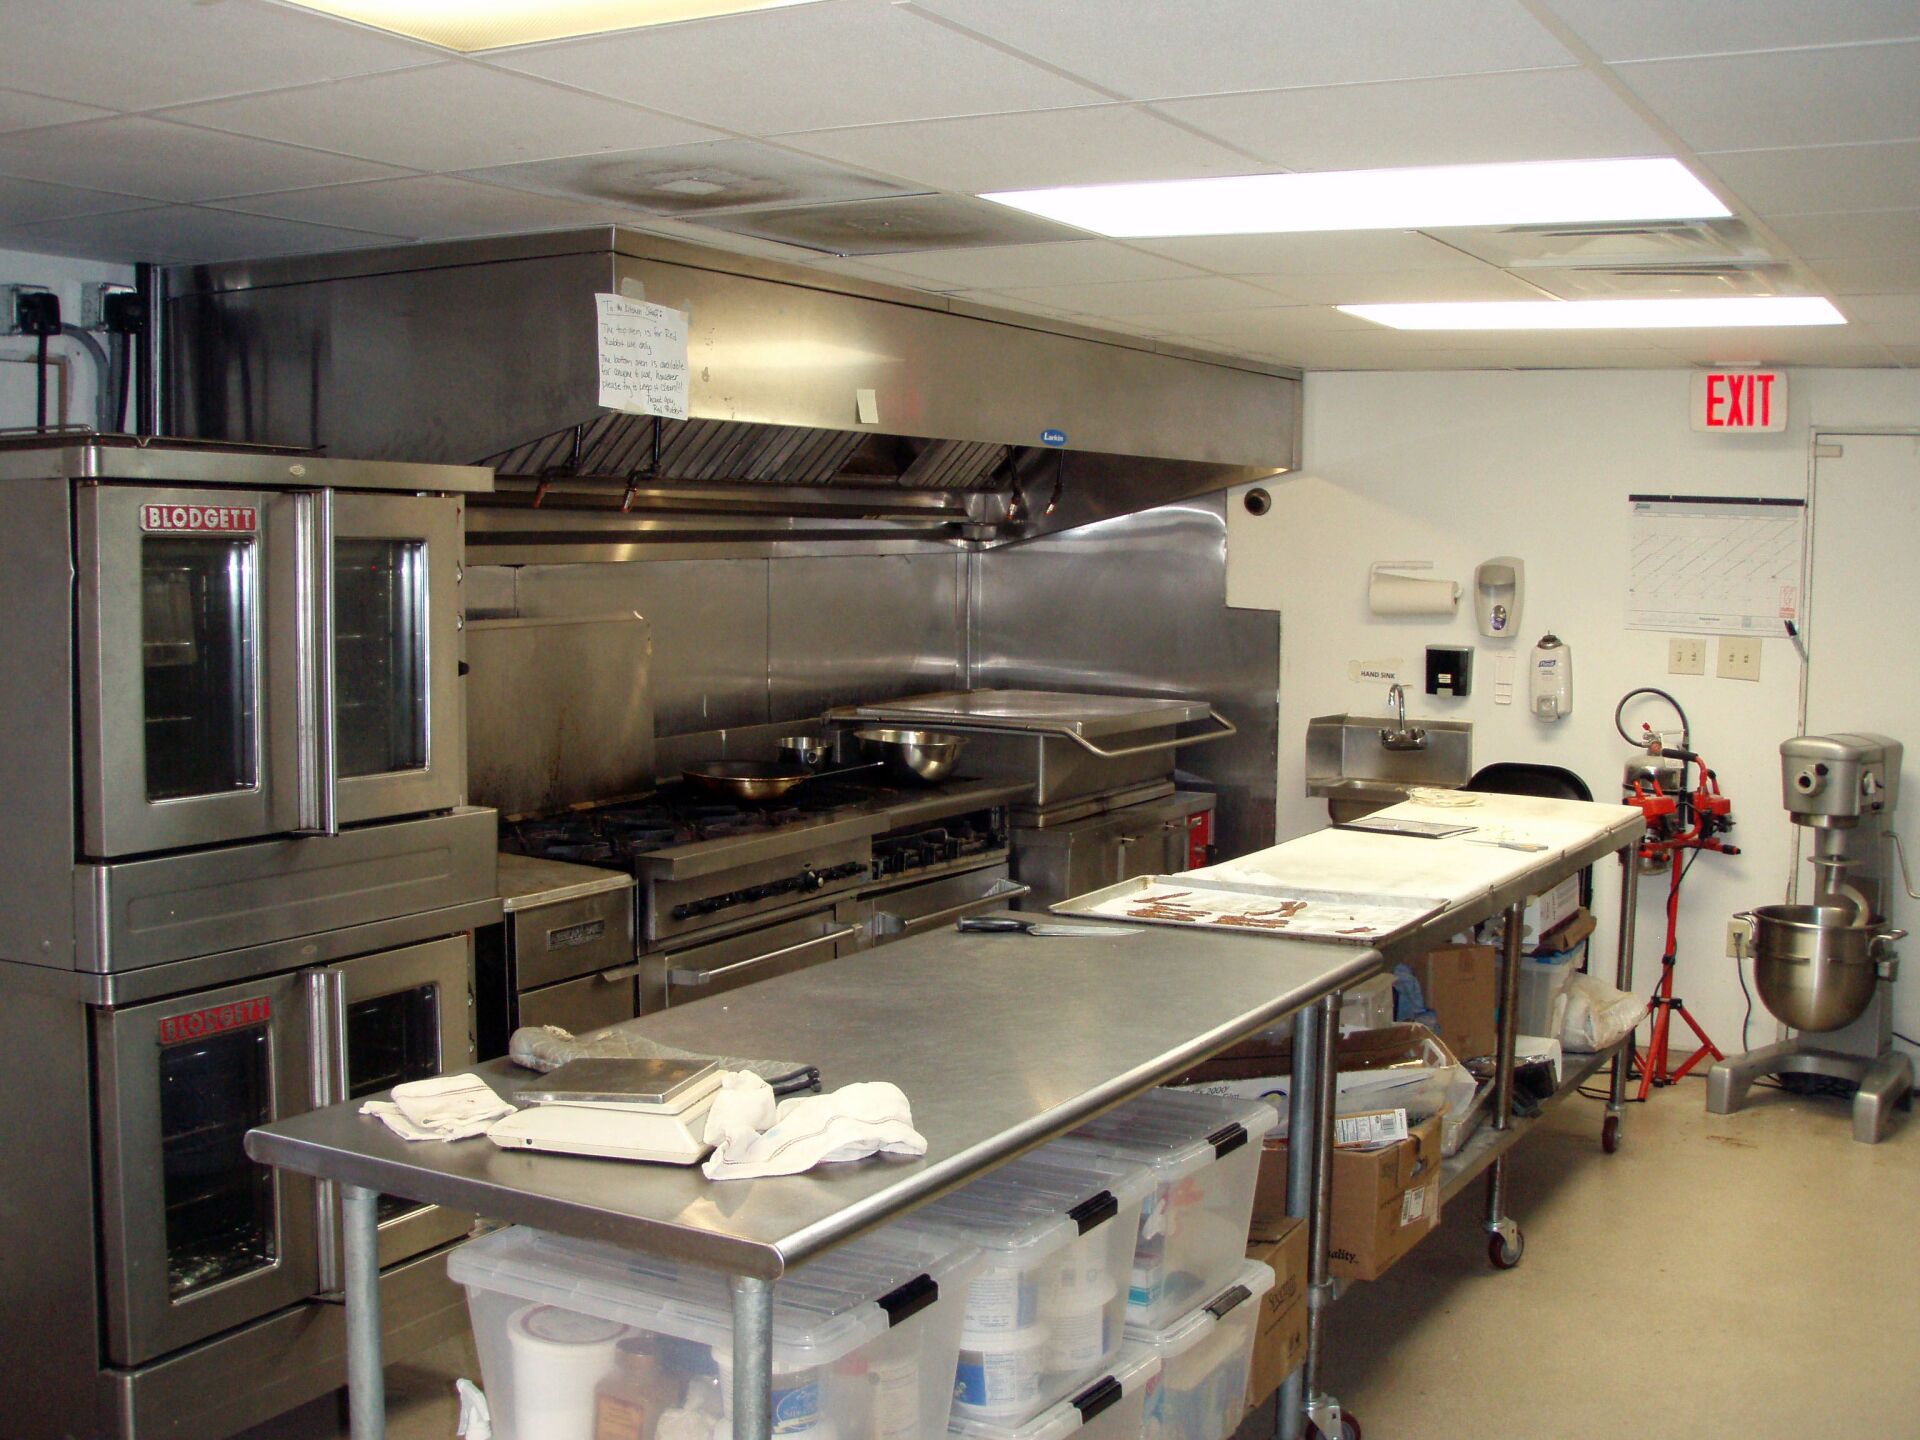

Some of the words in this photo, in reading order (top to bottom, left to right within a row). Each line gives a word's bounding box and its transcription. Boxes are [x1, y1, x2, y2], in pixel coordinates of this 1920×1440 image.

[600, 322, 613, 334] The
[600, 354, 613, 363] The
[634, 359, 648, 368] oven
[601, 364, 611, 375] for
[602, 380, 621, 392] please
[1707, 374, 1775, 427] EXIT
[149, 507, 252, 529] BLODGETT
[1360, 670, 1380, 678] HAND
[165, 998, 267, 1039] BLODGETT
